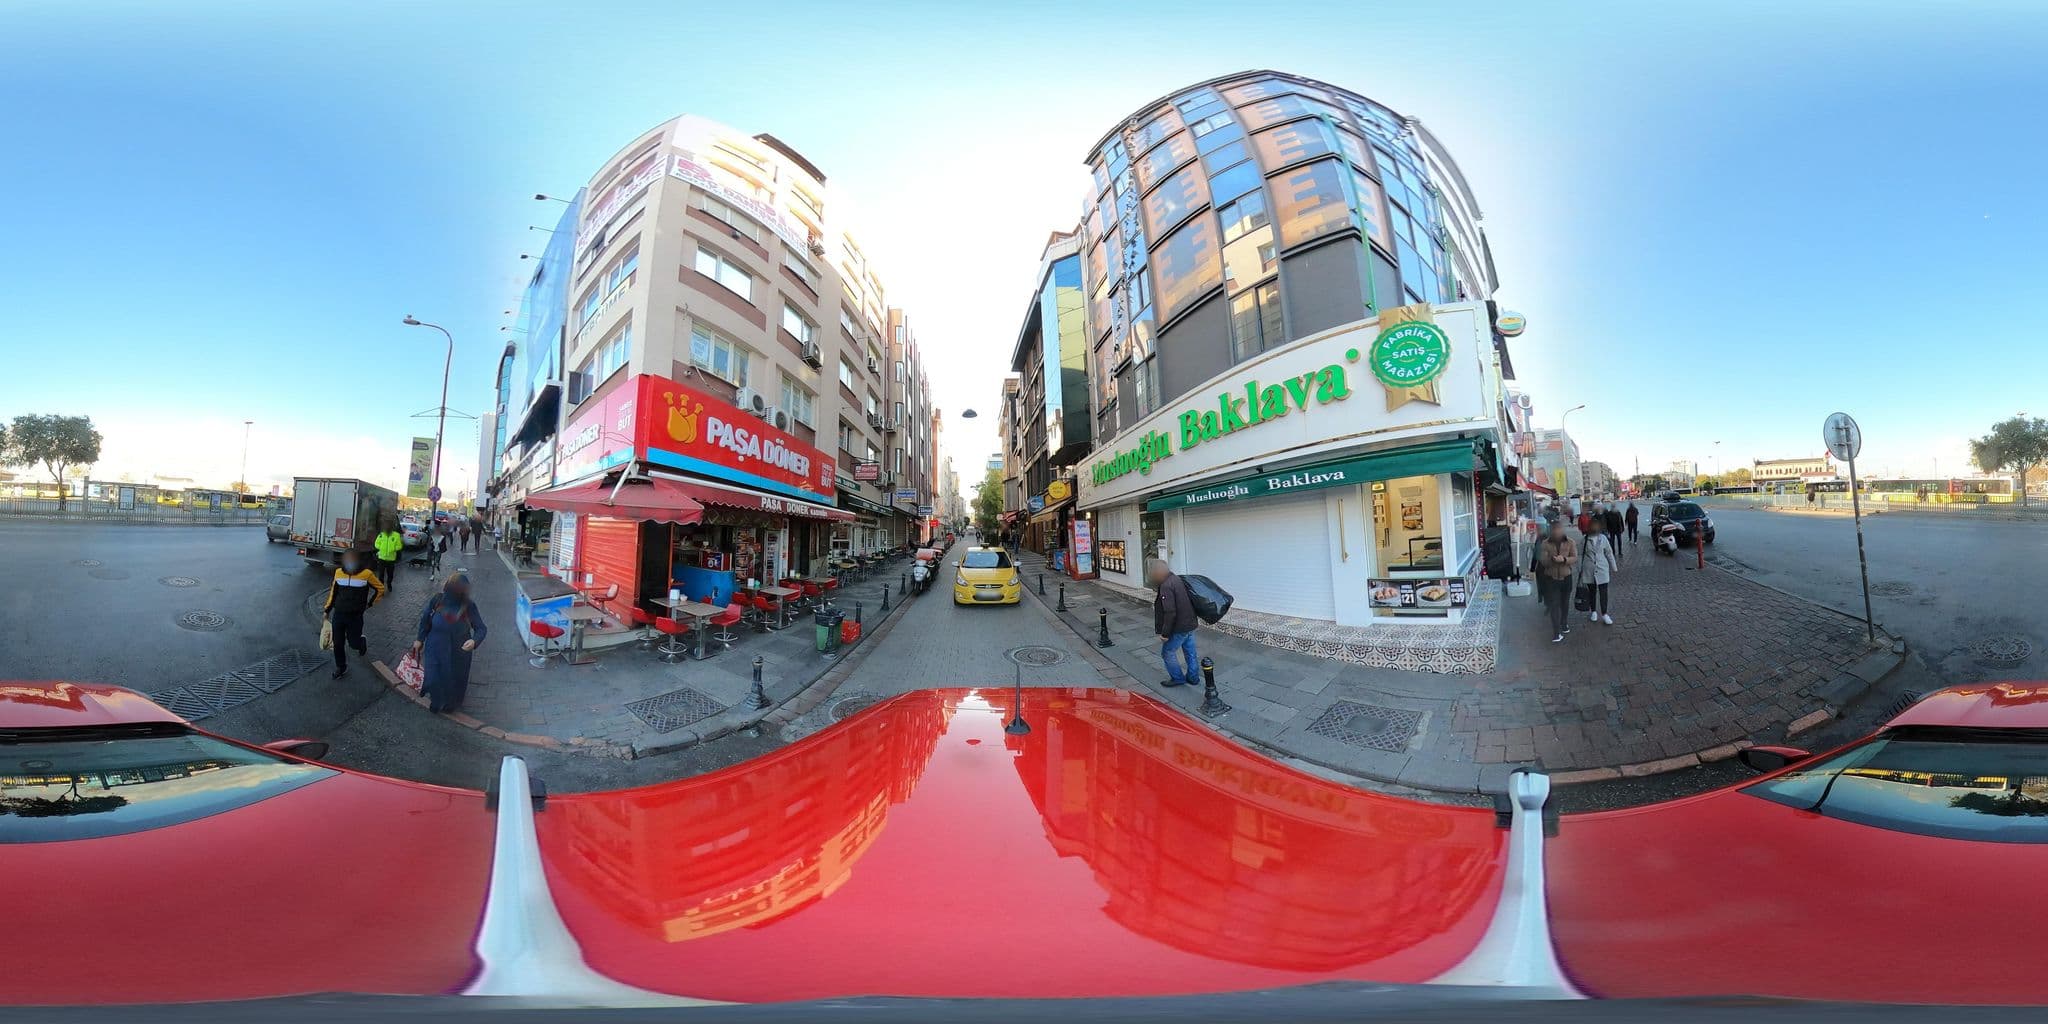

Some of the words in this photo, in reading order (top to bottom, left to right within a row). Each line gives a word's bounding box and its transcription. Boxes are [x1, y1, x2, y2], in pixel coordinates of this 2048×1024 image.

[1382, 327, 1432, 349] FABRİKA
[1382, 353, 1438, 378] MAĞAZASI
[1091, 429, 1174, 476] Musluoğlu
[1178, 364, 1350, 451] Baklava
[707, 416, 762, 462] PAŞA
[763, 438, 810, 477] DÖNER
[1186, 485, 1249, 504] Musluoğlu
[1267, 471, 1345, 490] Baklava
